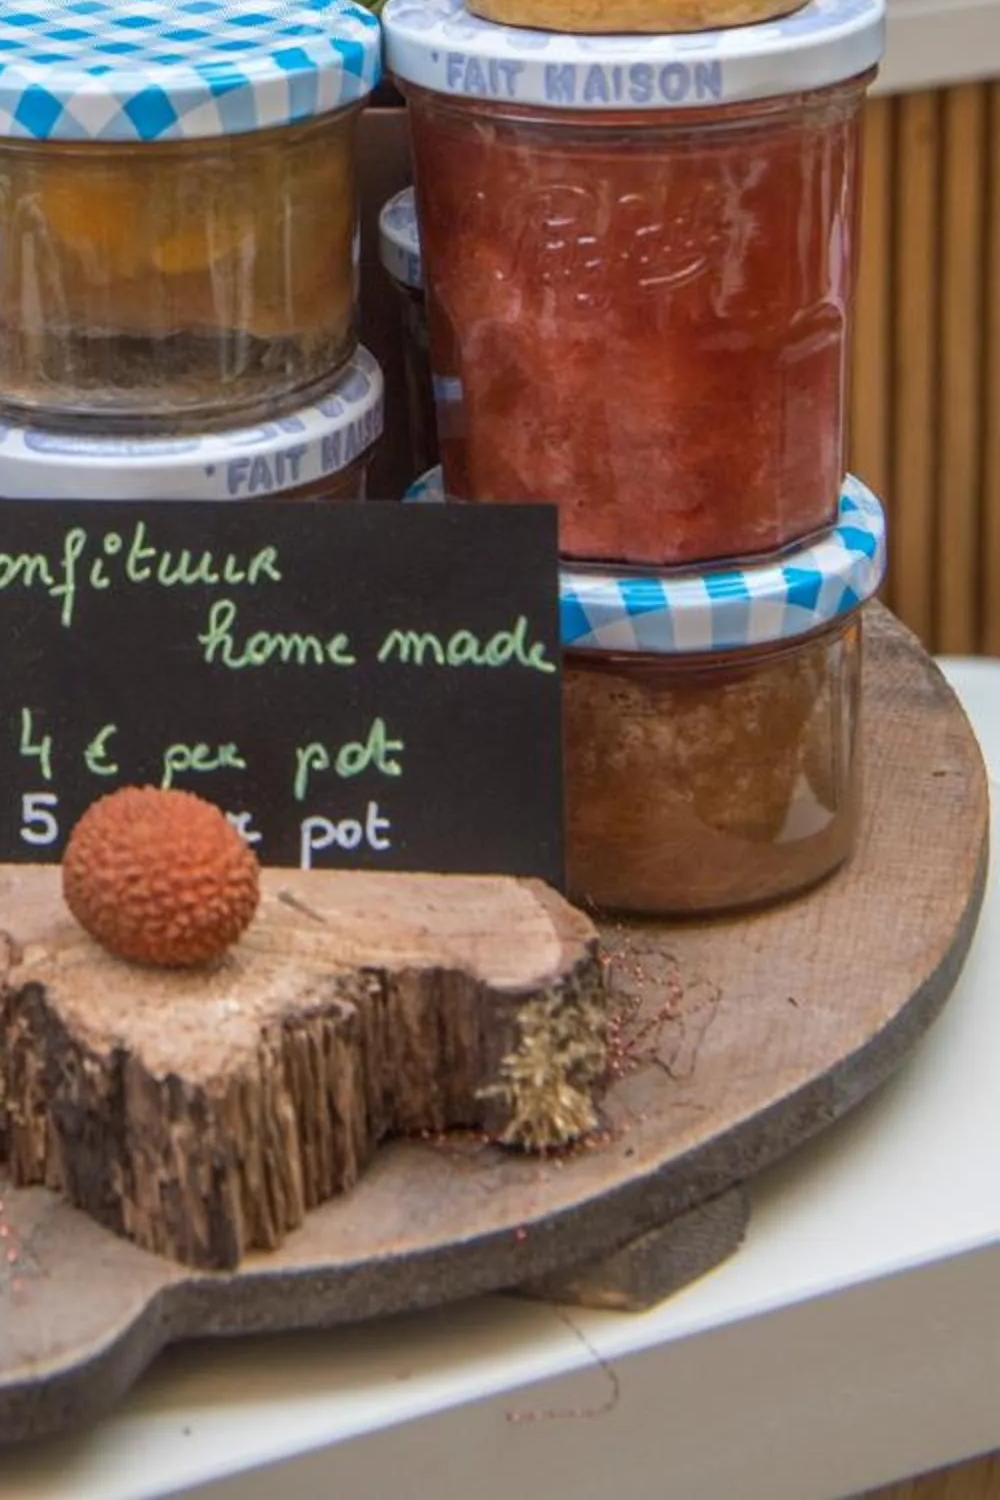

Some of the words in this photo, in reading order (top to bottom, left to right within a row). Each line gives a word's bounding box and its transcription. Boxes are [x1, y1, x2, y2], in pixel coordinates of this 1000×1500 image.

[445, 51, 525, 97] FAIT
[544, 60, 722, 103] MAISON
[227, 444, 309, 495] FAIT
[198, 599, 356, 668] home
[378, 615, 557, 673] made
[19, 707, 52, 781] 4
[84, 723, 119, 775] €
[161, 743, 247, 791] per
[294, 717, 405, 800] pot
[19, 793, 60, 845] 5
[301, 801, 391, 869] pot
